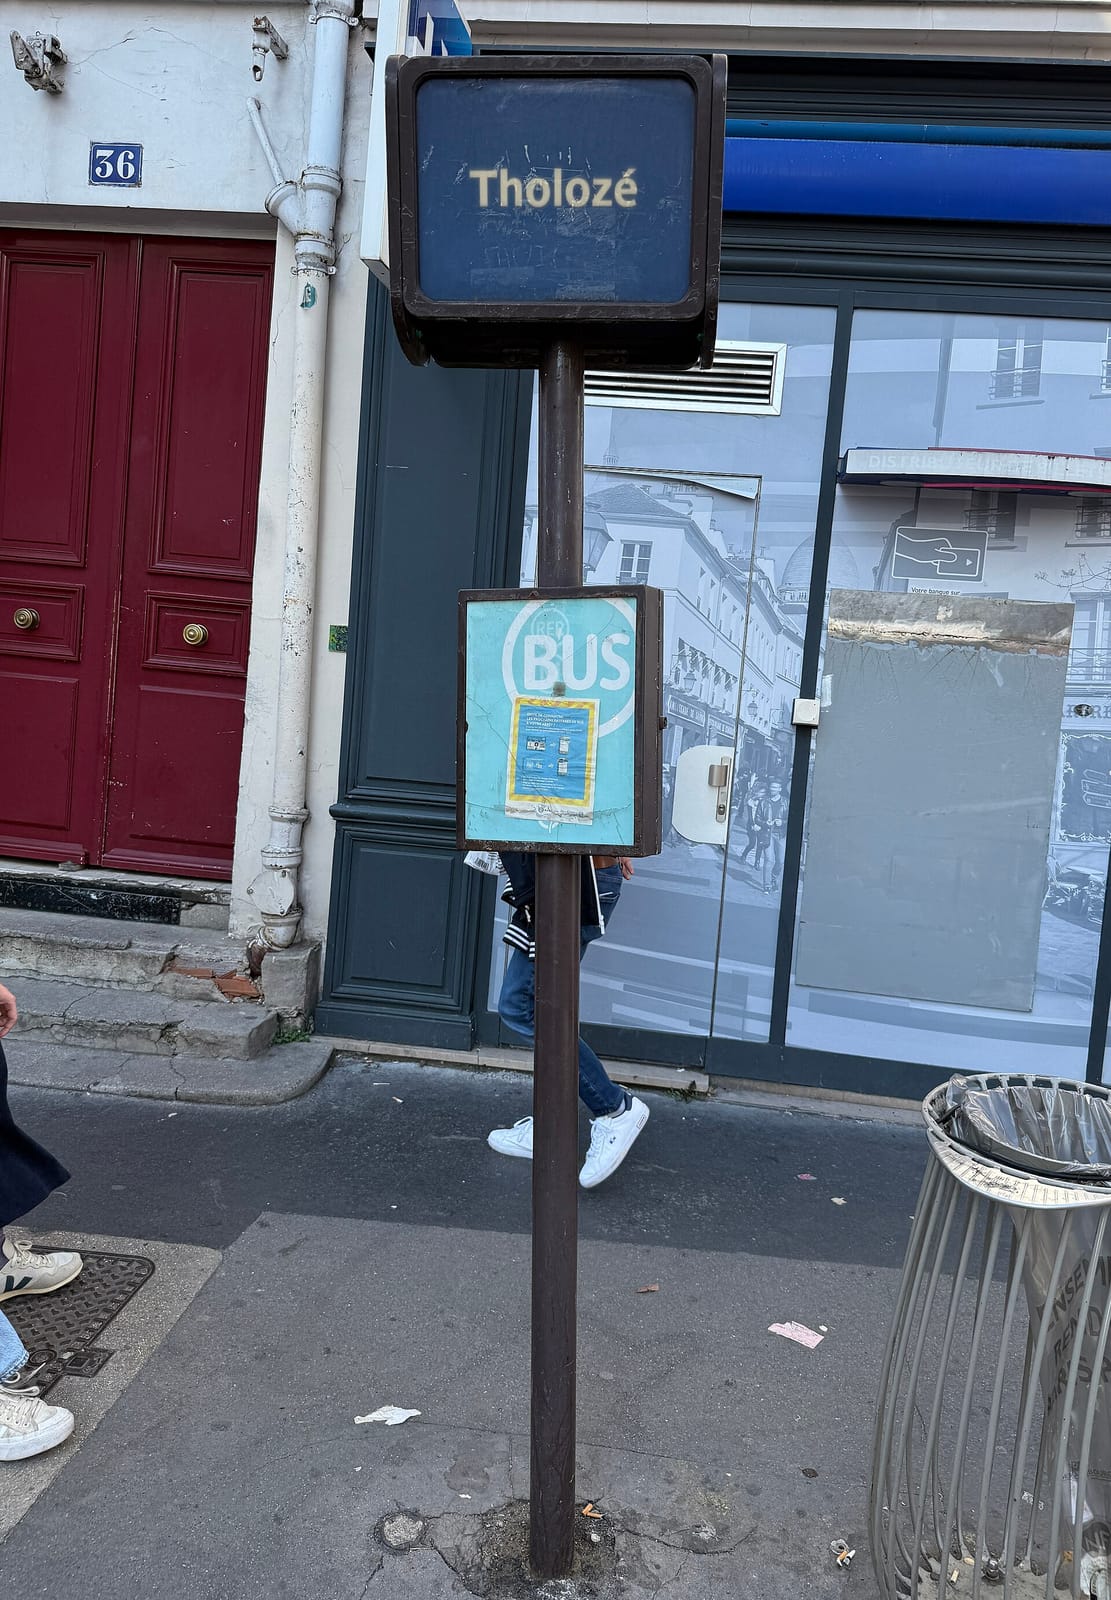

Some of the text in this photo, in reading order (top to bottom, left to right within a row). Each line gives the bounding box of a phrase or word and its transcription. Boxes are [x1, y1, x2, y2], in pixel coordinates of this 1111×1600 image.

[95, 149, 135, 180] 36
[469, 167, 638, 208] Tholozé
[524, 633, 631, 690] BUS
